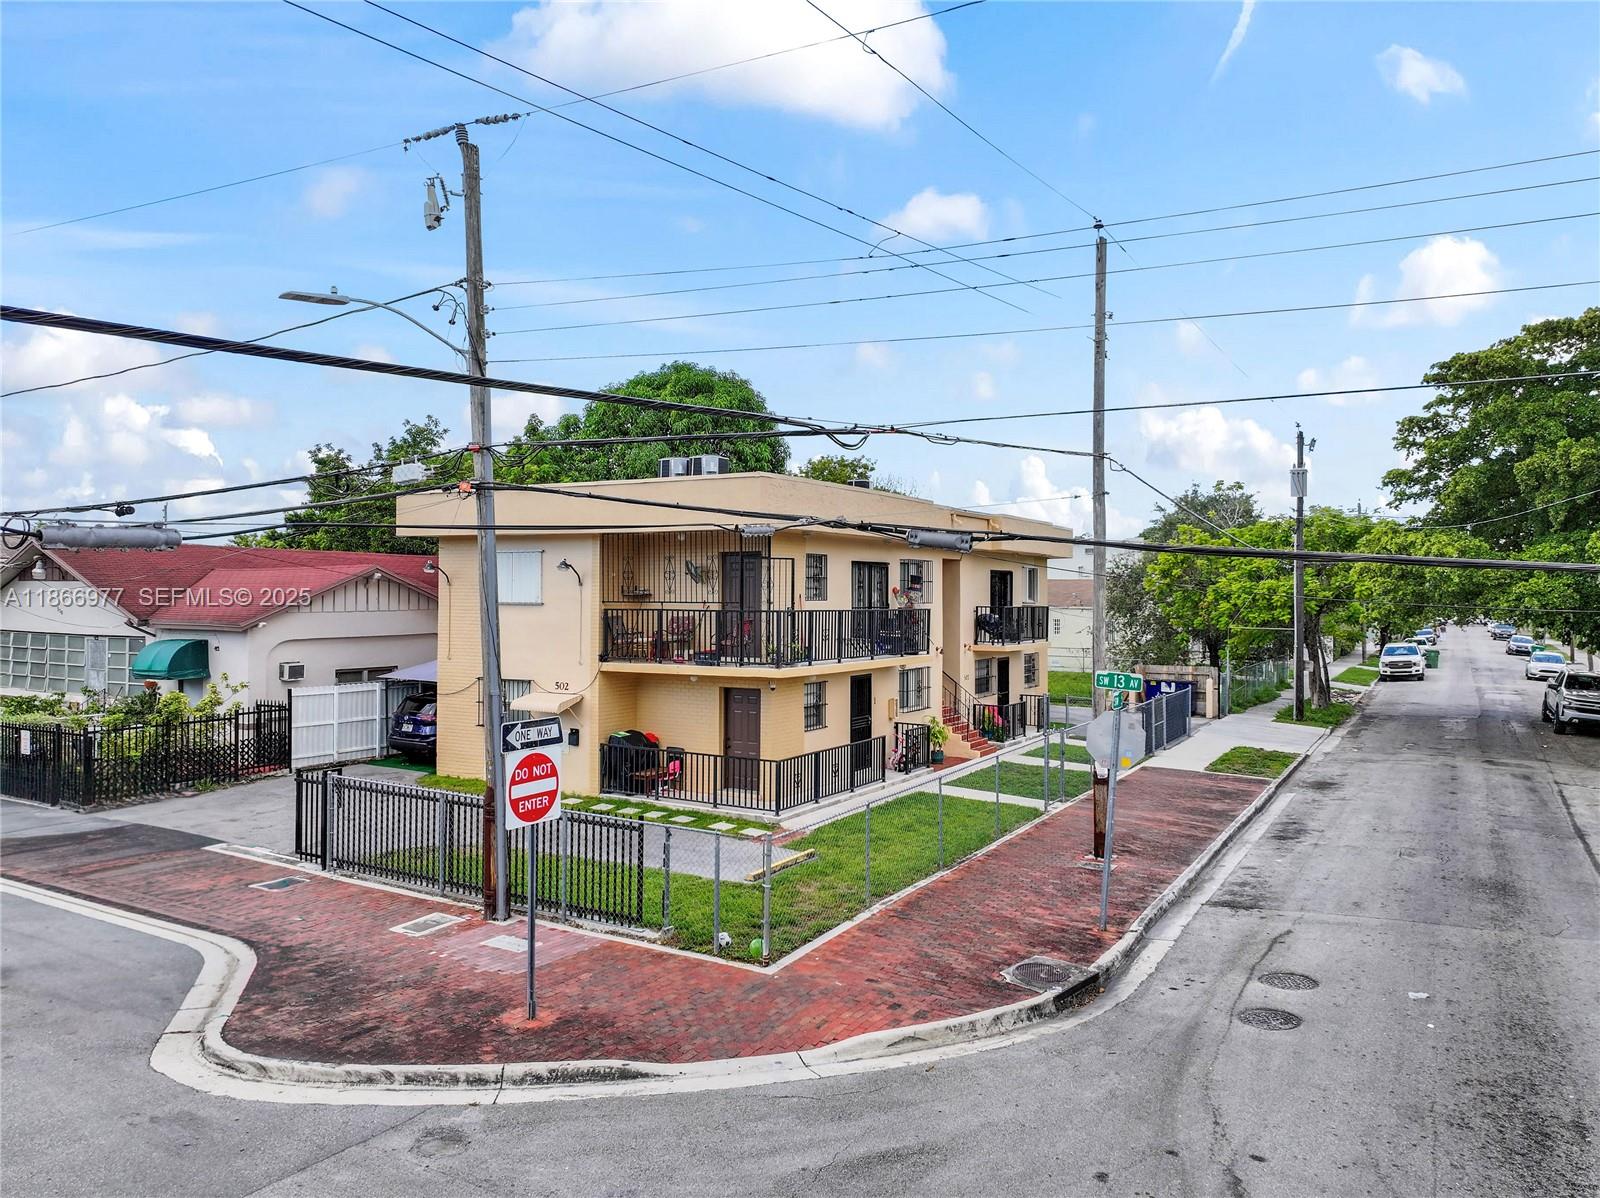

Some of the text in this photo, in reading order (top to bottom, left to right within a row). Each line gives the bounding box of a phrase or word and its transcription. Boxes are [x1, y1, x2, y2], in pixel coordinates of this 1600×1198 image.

[554, 681, 570, 691] 502
[1098, 675, 1110, 687] SW
[1113, 674, 1125, 688] 13
[514, 726, 553, 743] ONE WAY
[514, 762, 553, 782] DO NOT
[518, 795, 549, 813] ENTER
